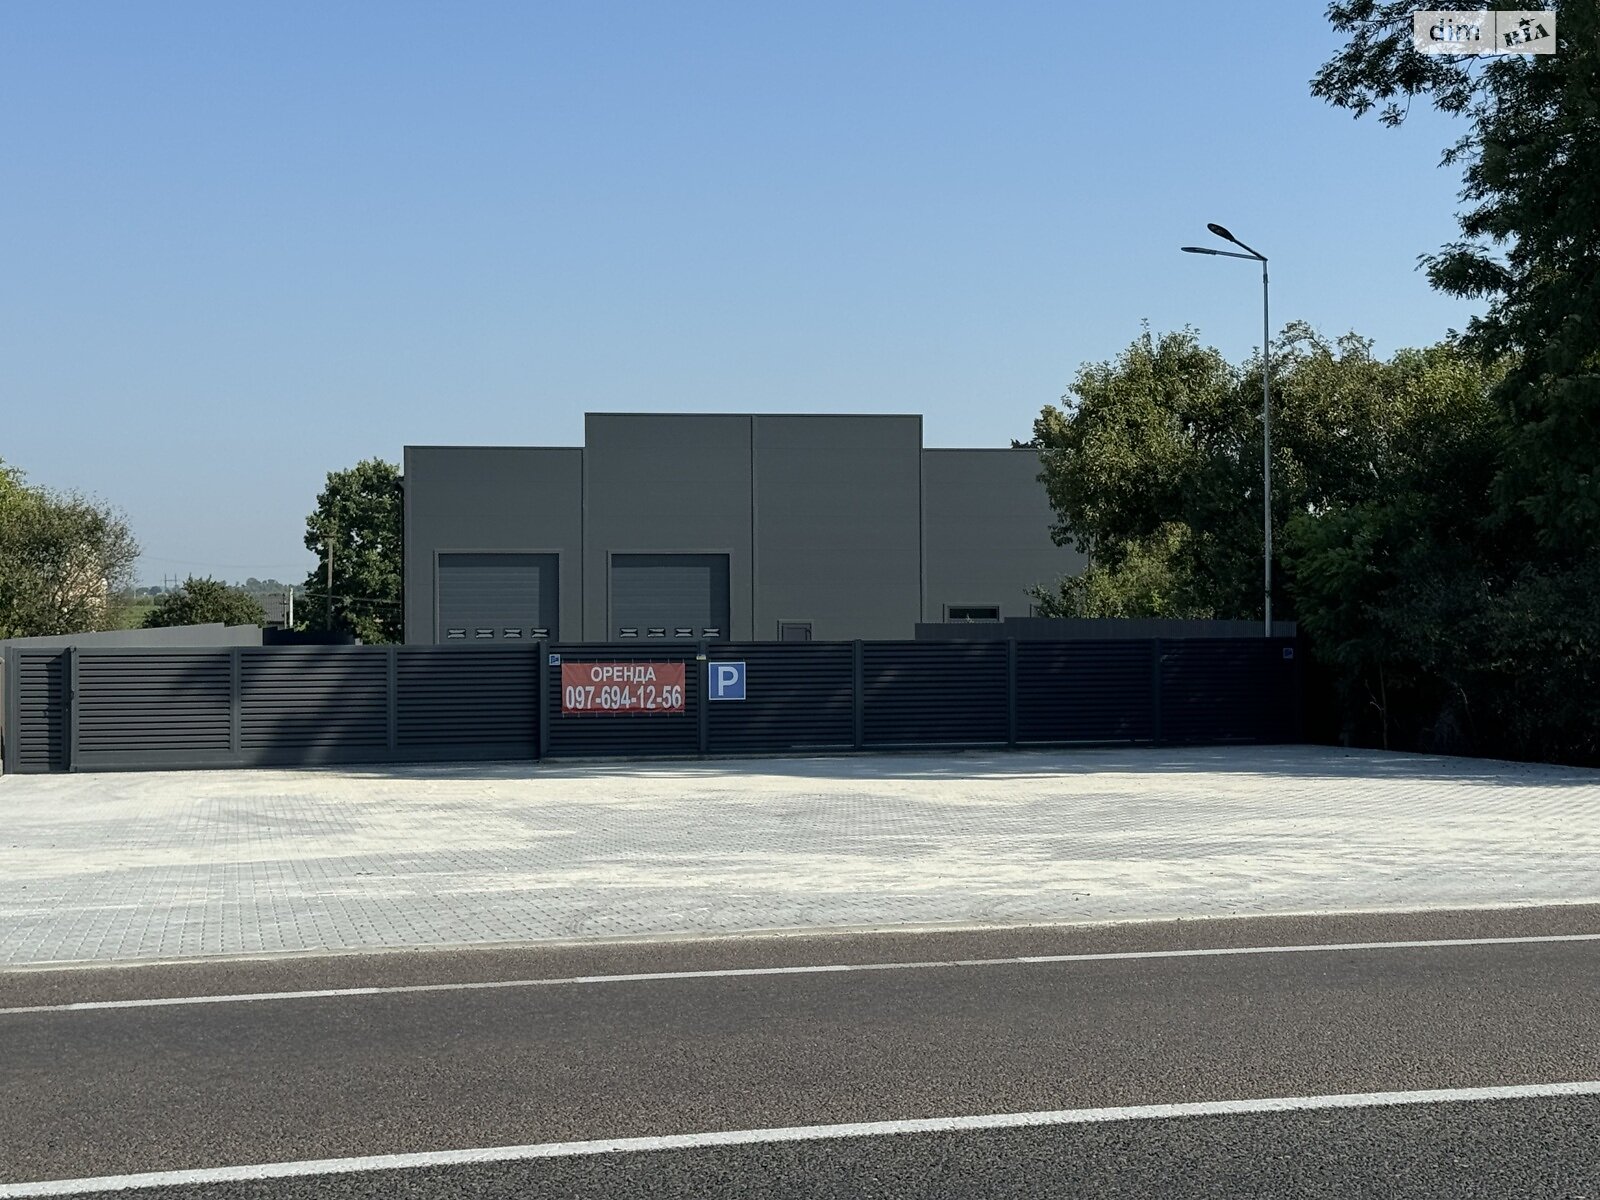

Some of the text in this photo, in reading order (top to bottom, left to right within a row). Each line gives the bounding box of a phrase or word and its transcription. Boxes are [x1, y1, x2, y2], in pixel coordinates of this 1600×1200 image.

[590, 666, 657, 684] ОРЕНДА
[718, 666, 739, 696] P
[566, 685, 682, 709] 097-694-12-56
